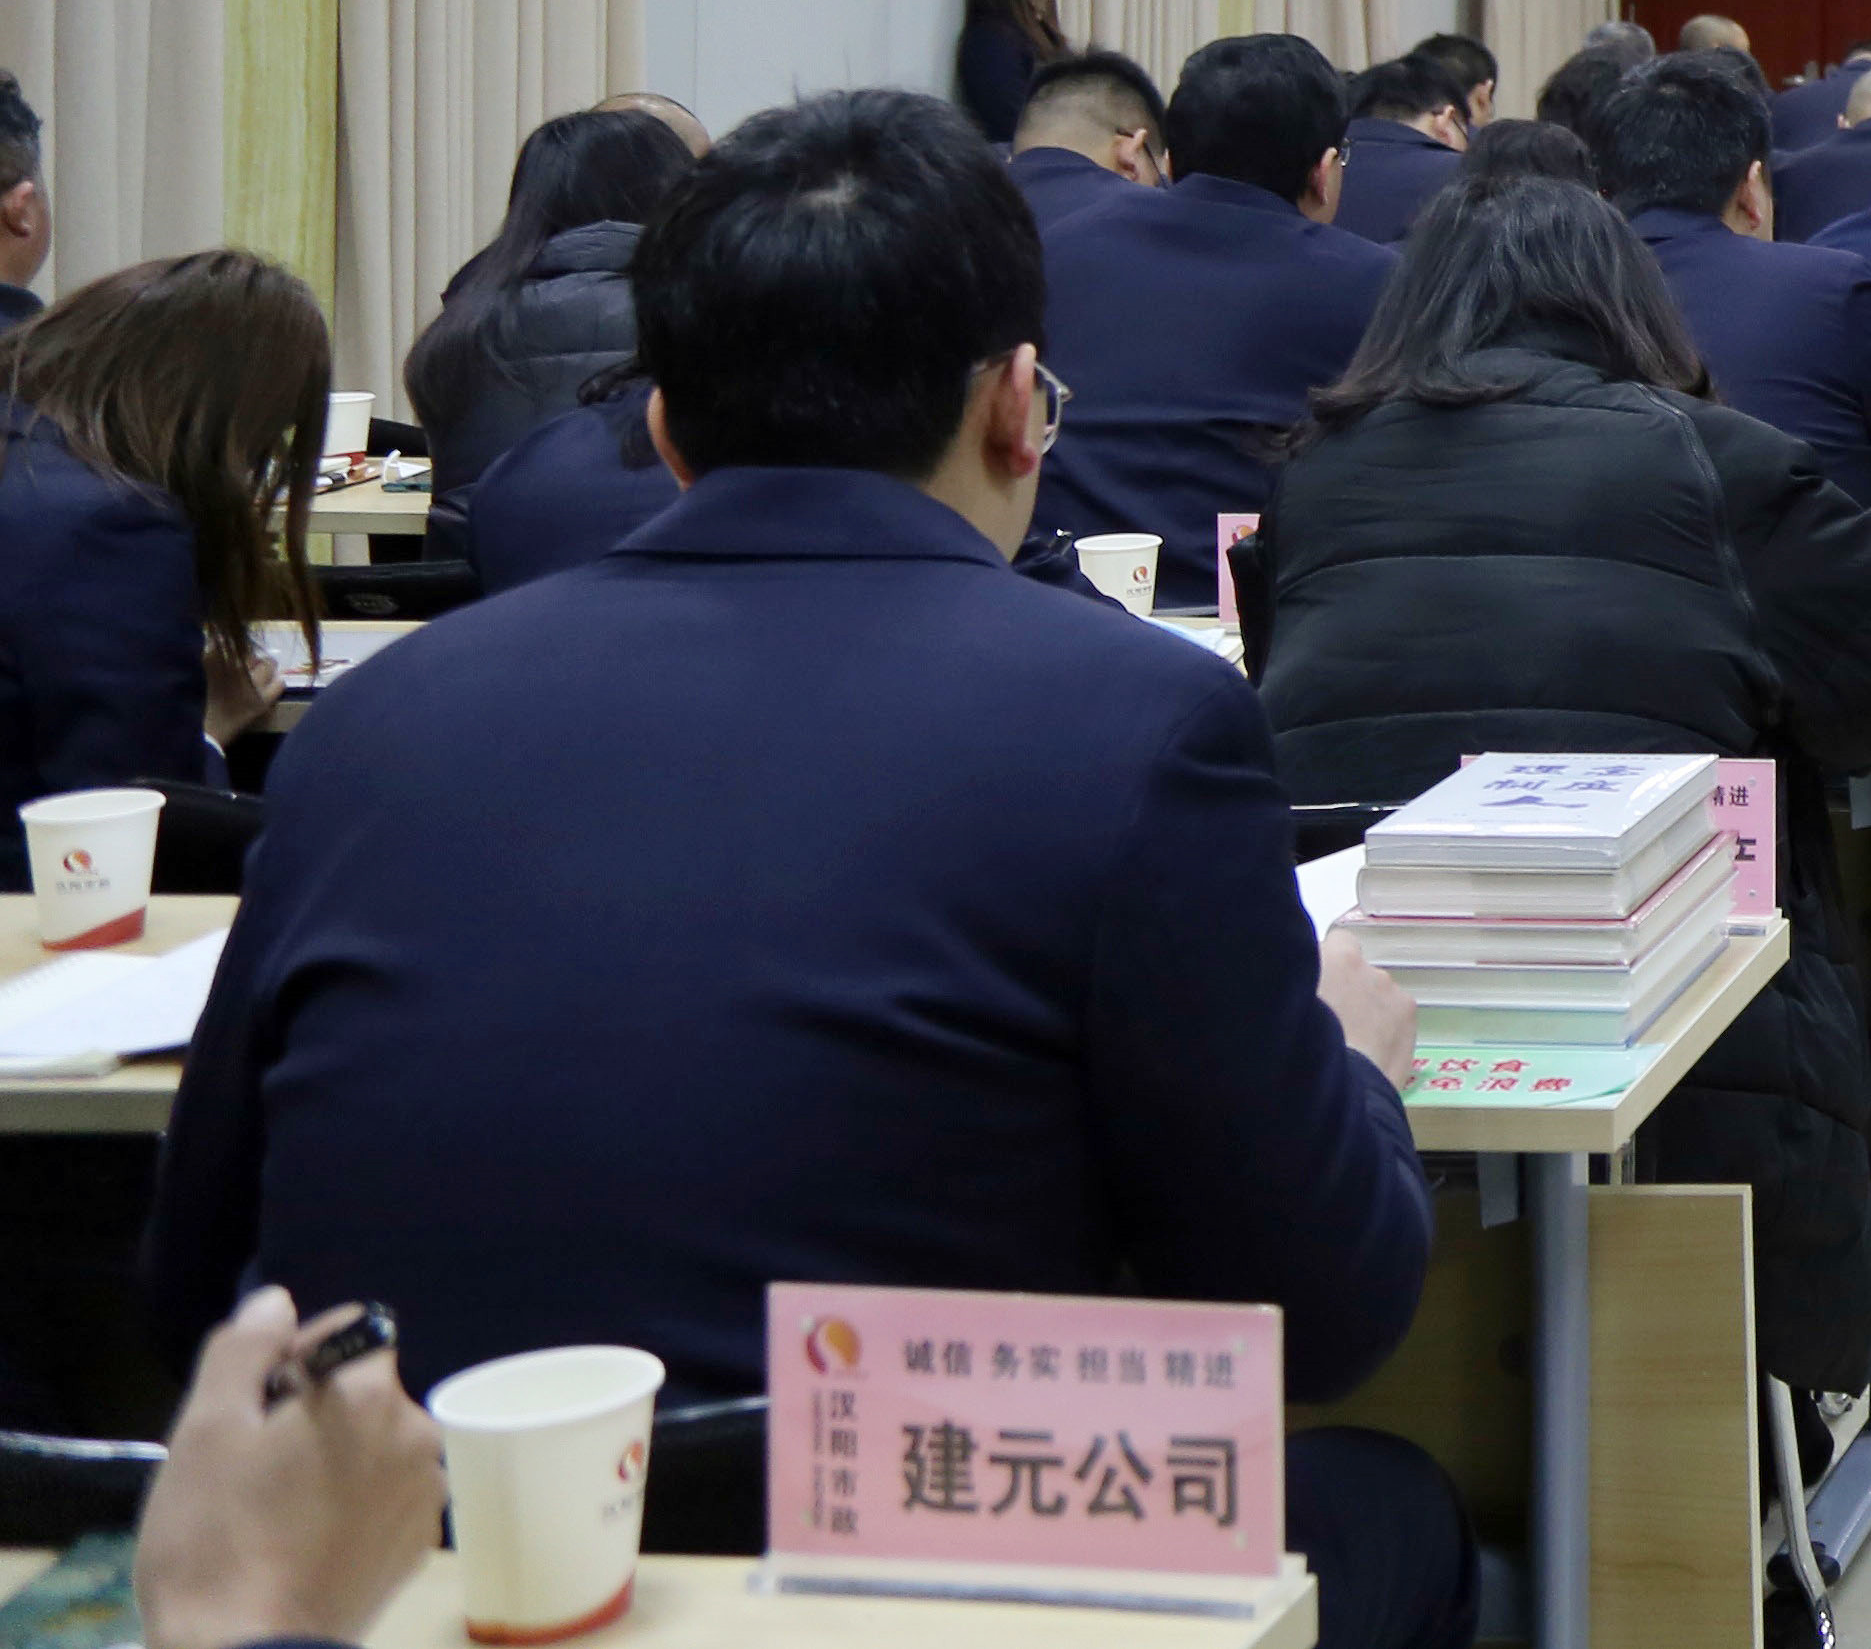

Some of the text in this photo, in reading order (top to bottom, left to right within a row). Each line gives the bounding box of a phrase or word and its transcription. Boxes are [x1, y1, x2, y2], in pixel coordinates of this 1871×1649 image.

[1403, 1076, 1574, 1093] 免浪费
[903, 1339, 973, 1376] 诚信
[991, 1341, 1062, 1382] 务实
[1076, 1347, 1147, 1385] 担当
[902, 1418, 1240, 1528] 建元公司
